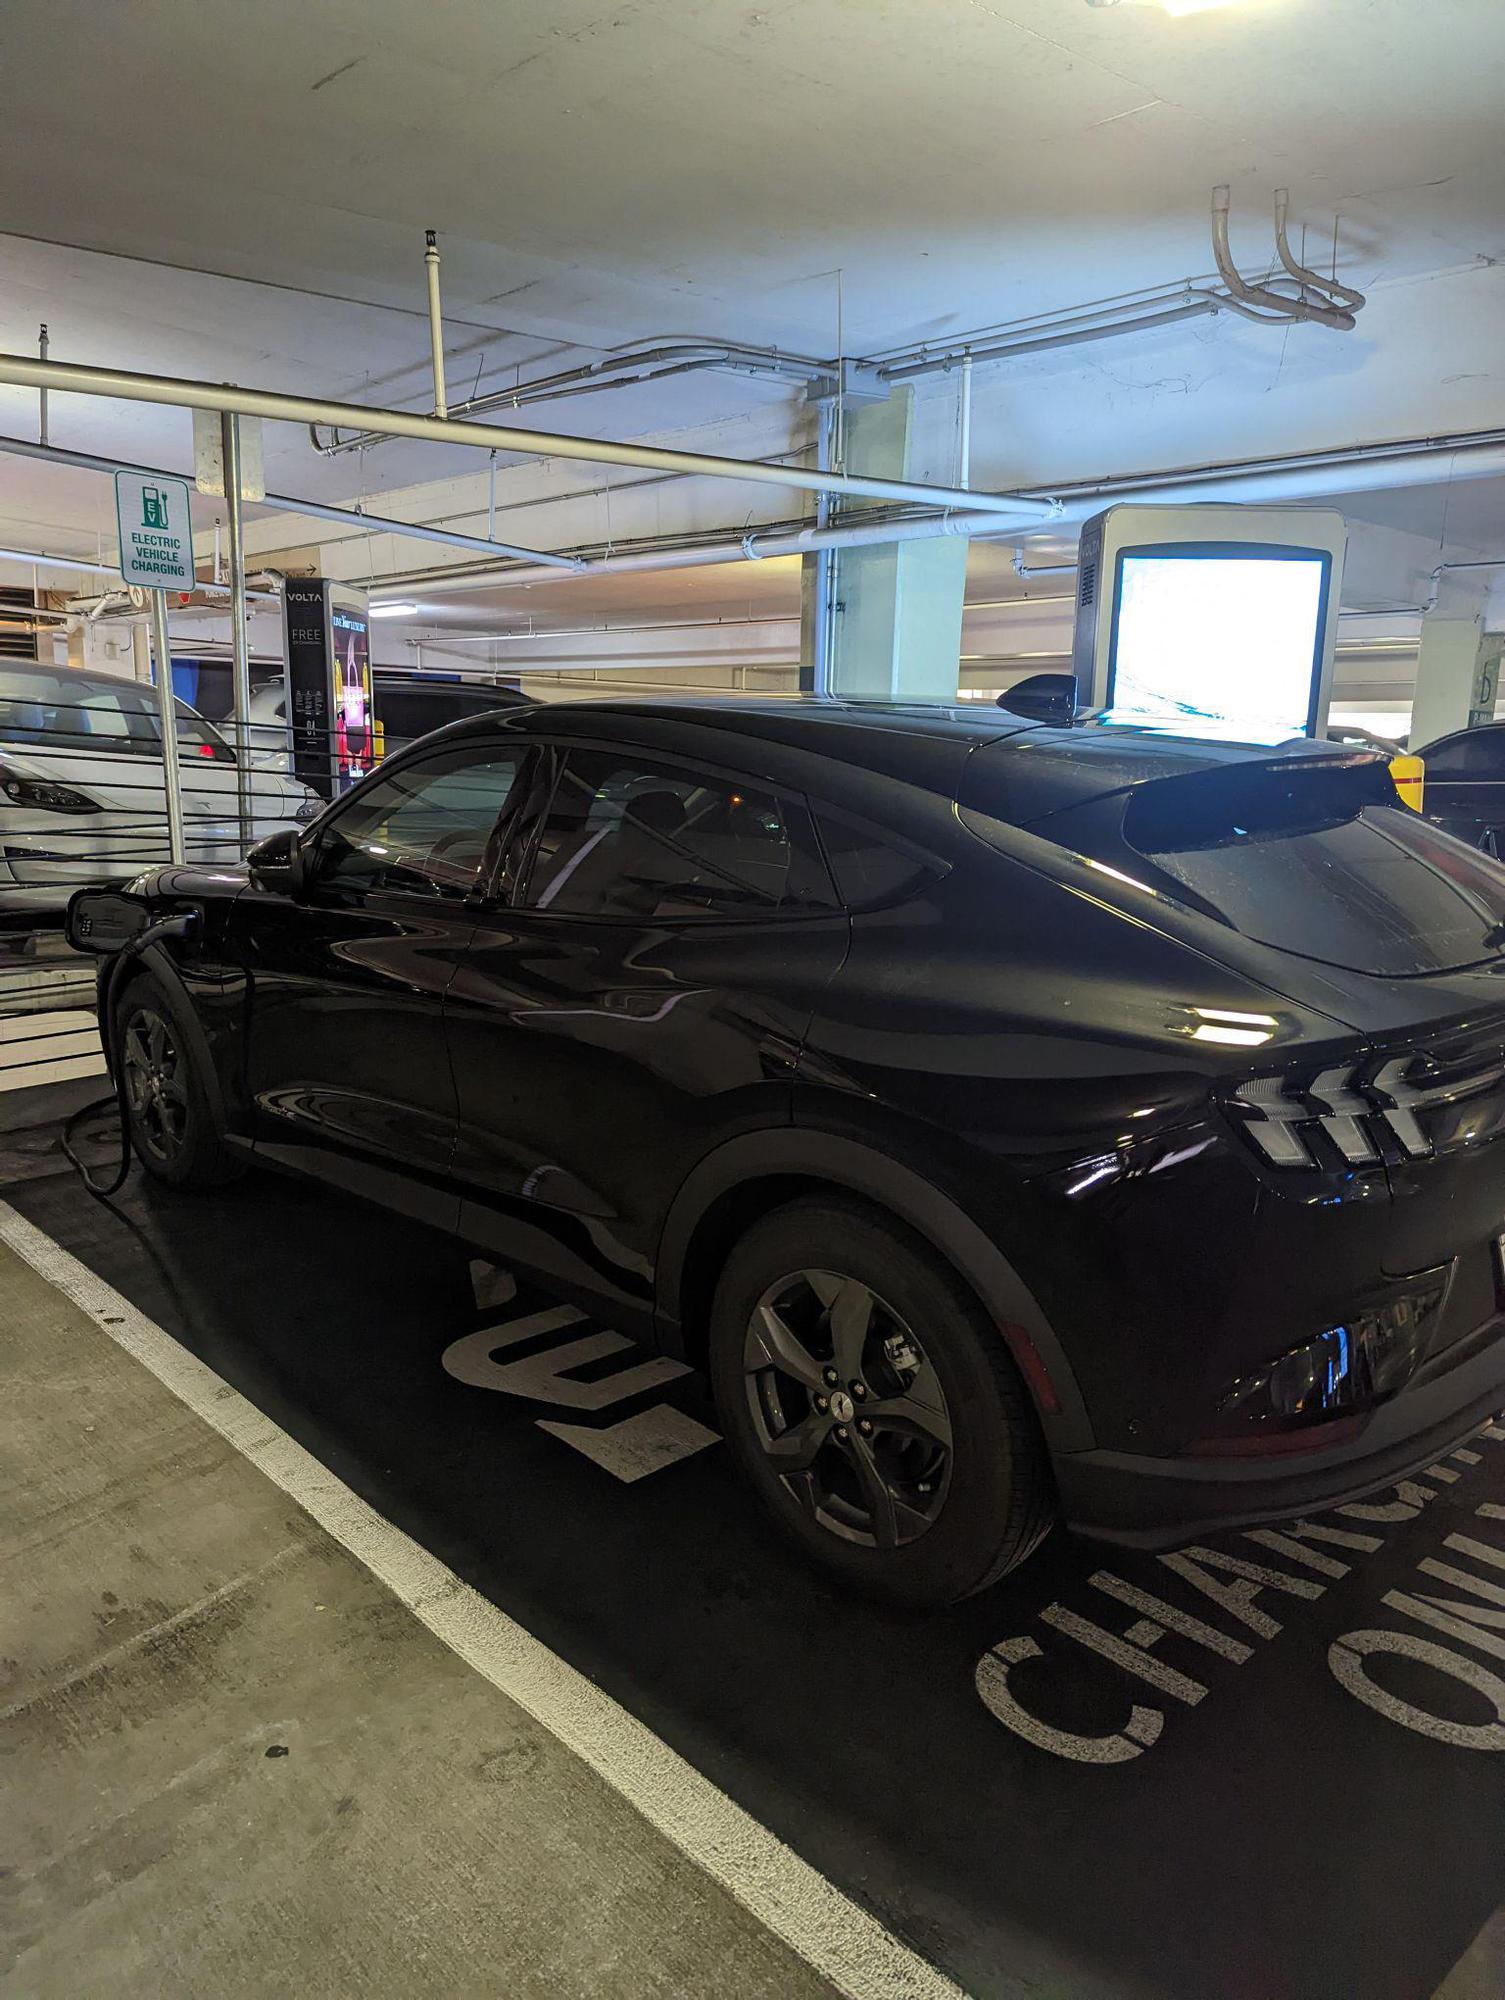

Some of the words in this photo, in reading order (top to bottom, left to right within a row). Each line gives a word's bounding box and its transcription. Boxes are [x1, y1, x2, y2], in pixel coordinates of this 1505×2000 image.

[147, 501, 156, 523] EV
[131, 532, 181, 549] ELECTRIC
[135, 546, 179, 563] VEHICLE
[131, 560, 185, 577] CHARGING
[287, 593, 323, 602] VOLTA
[292, 629, 321, 640] FREE
